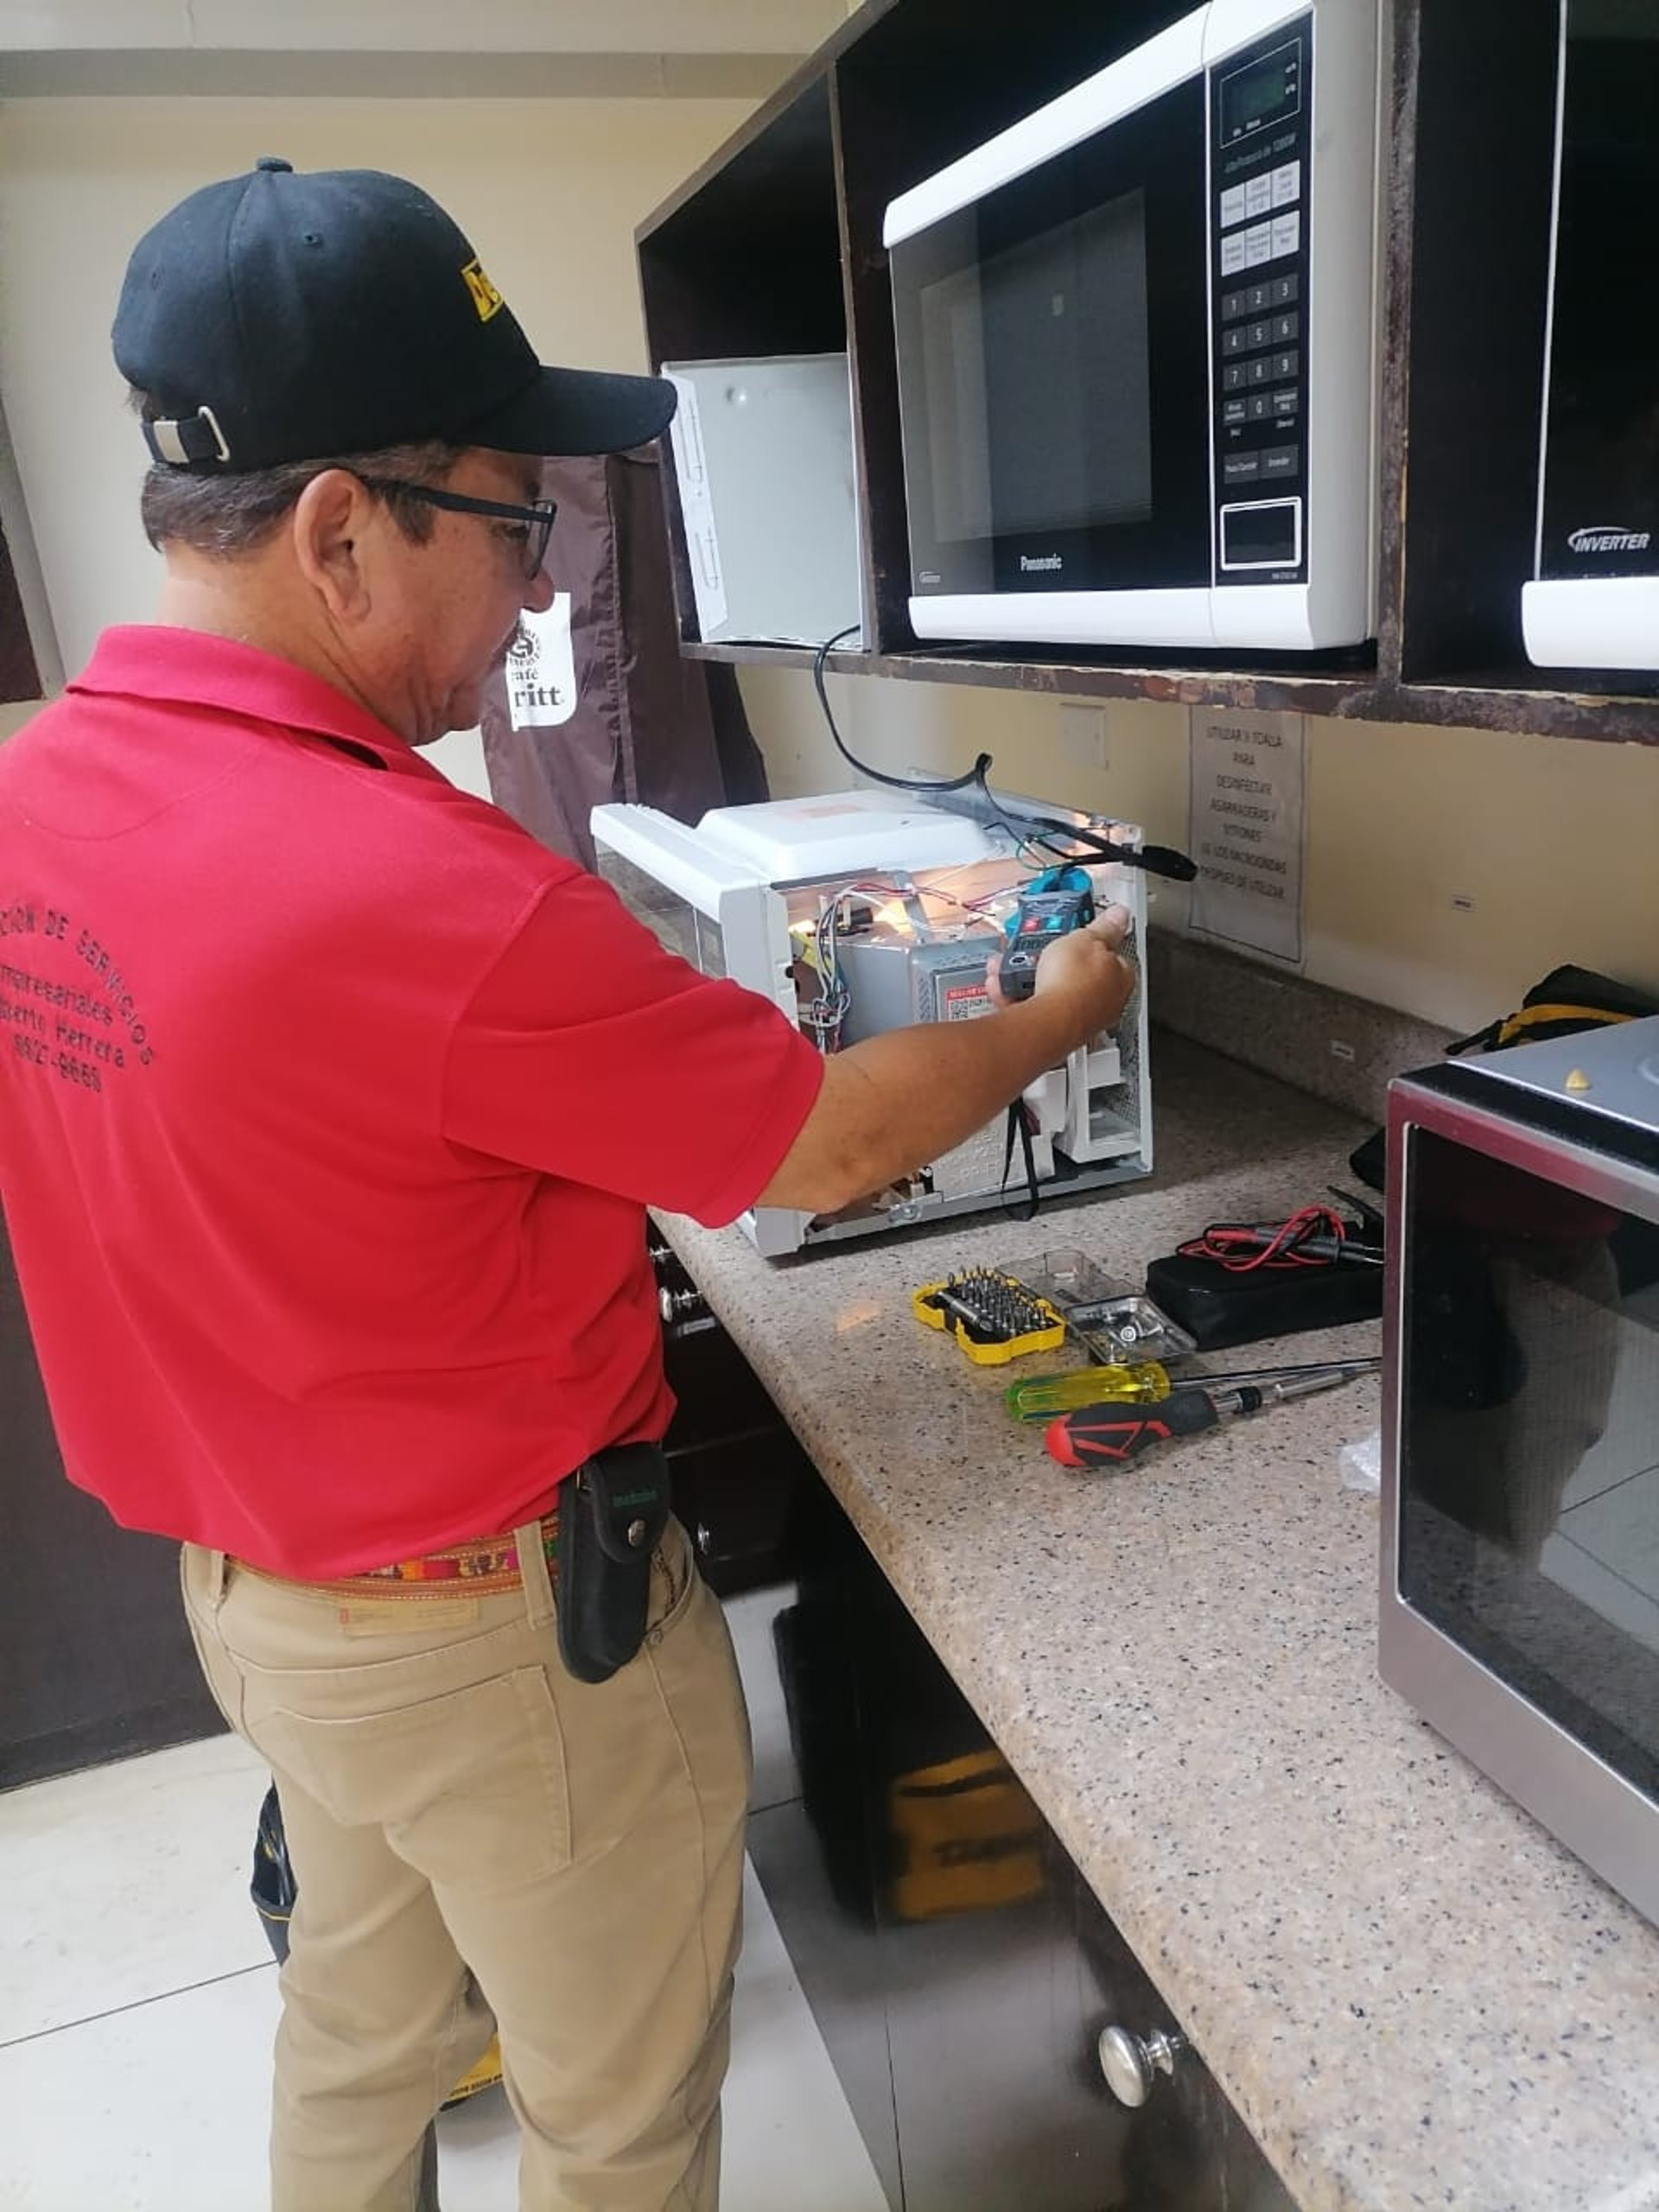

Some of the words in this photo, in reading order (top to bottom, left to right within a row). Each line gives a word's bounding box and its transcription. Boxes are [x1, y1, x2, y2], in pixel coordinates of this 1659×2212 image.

[1281, 282, 1288, 296] 3
[1255, 327, 1262, 341] 5
[1281, 321, 1289, 335] 6
[1281, 359, 1289, 372] 9
[1574, 532, 1651, 553] INVERTER
[1020, 553, 1063, 572] Panasonic
[45, 909, 69, 940] DE
[76, 928, 154, 1065] SERVICIOS
